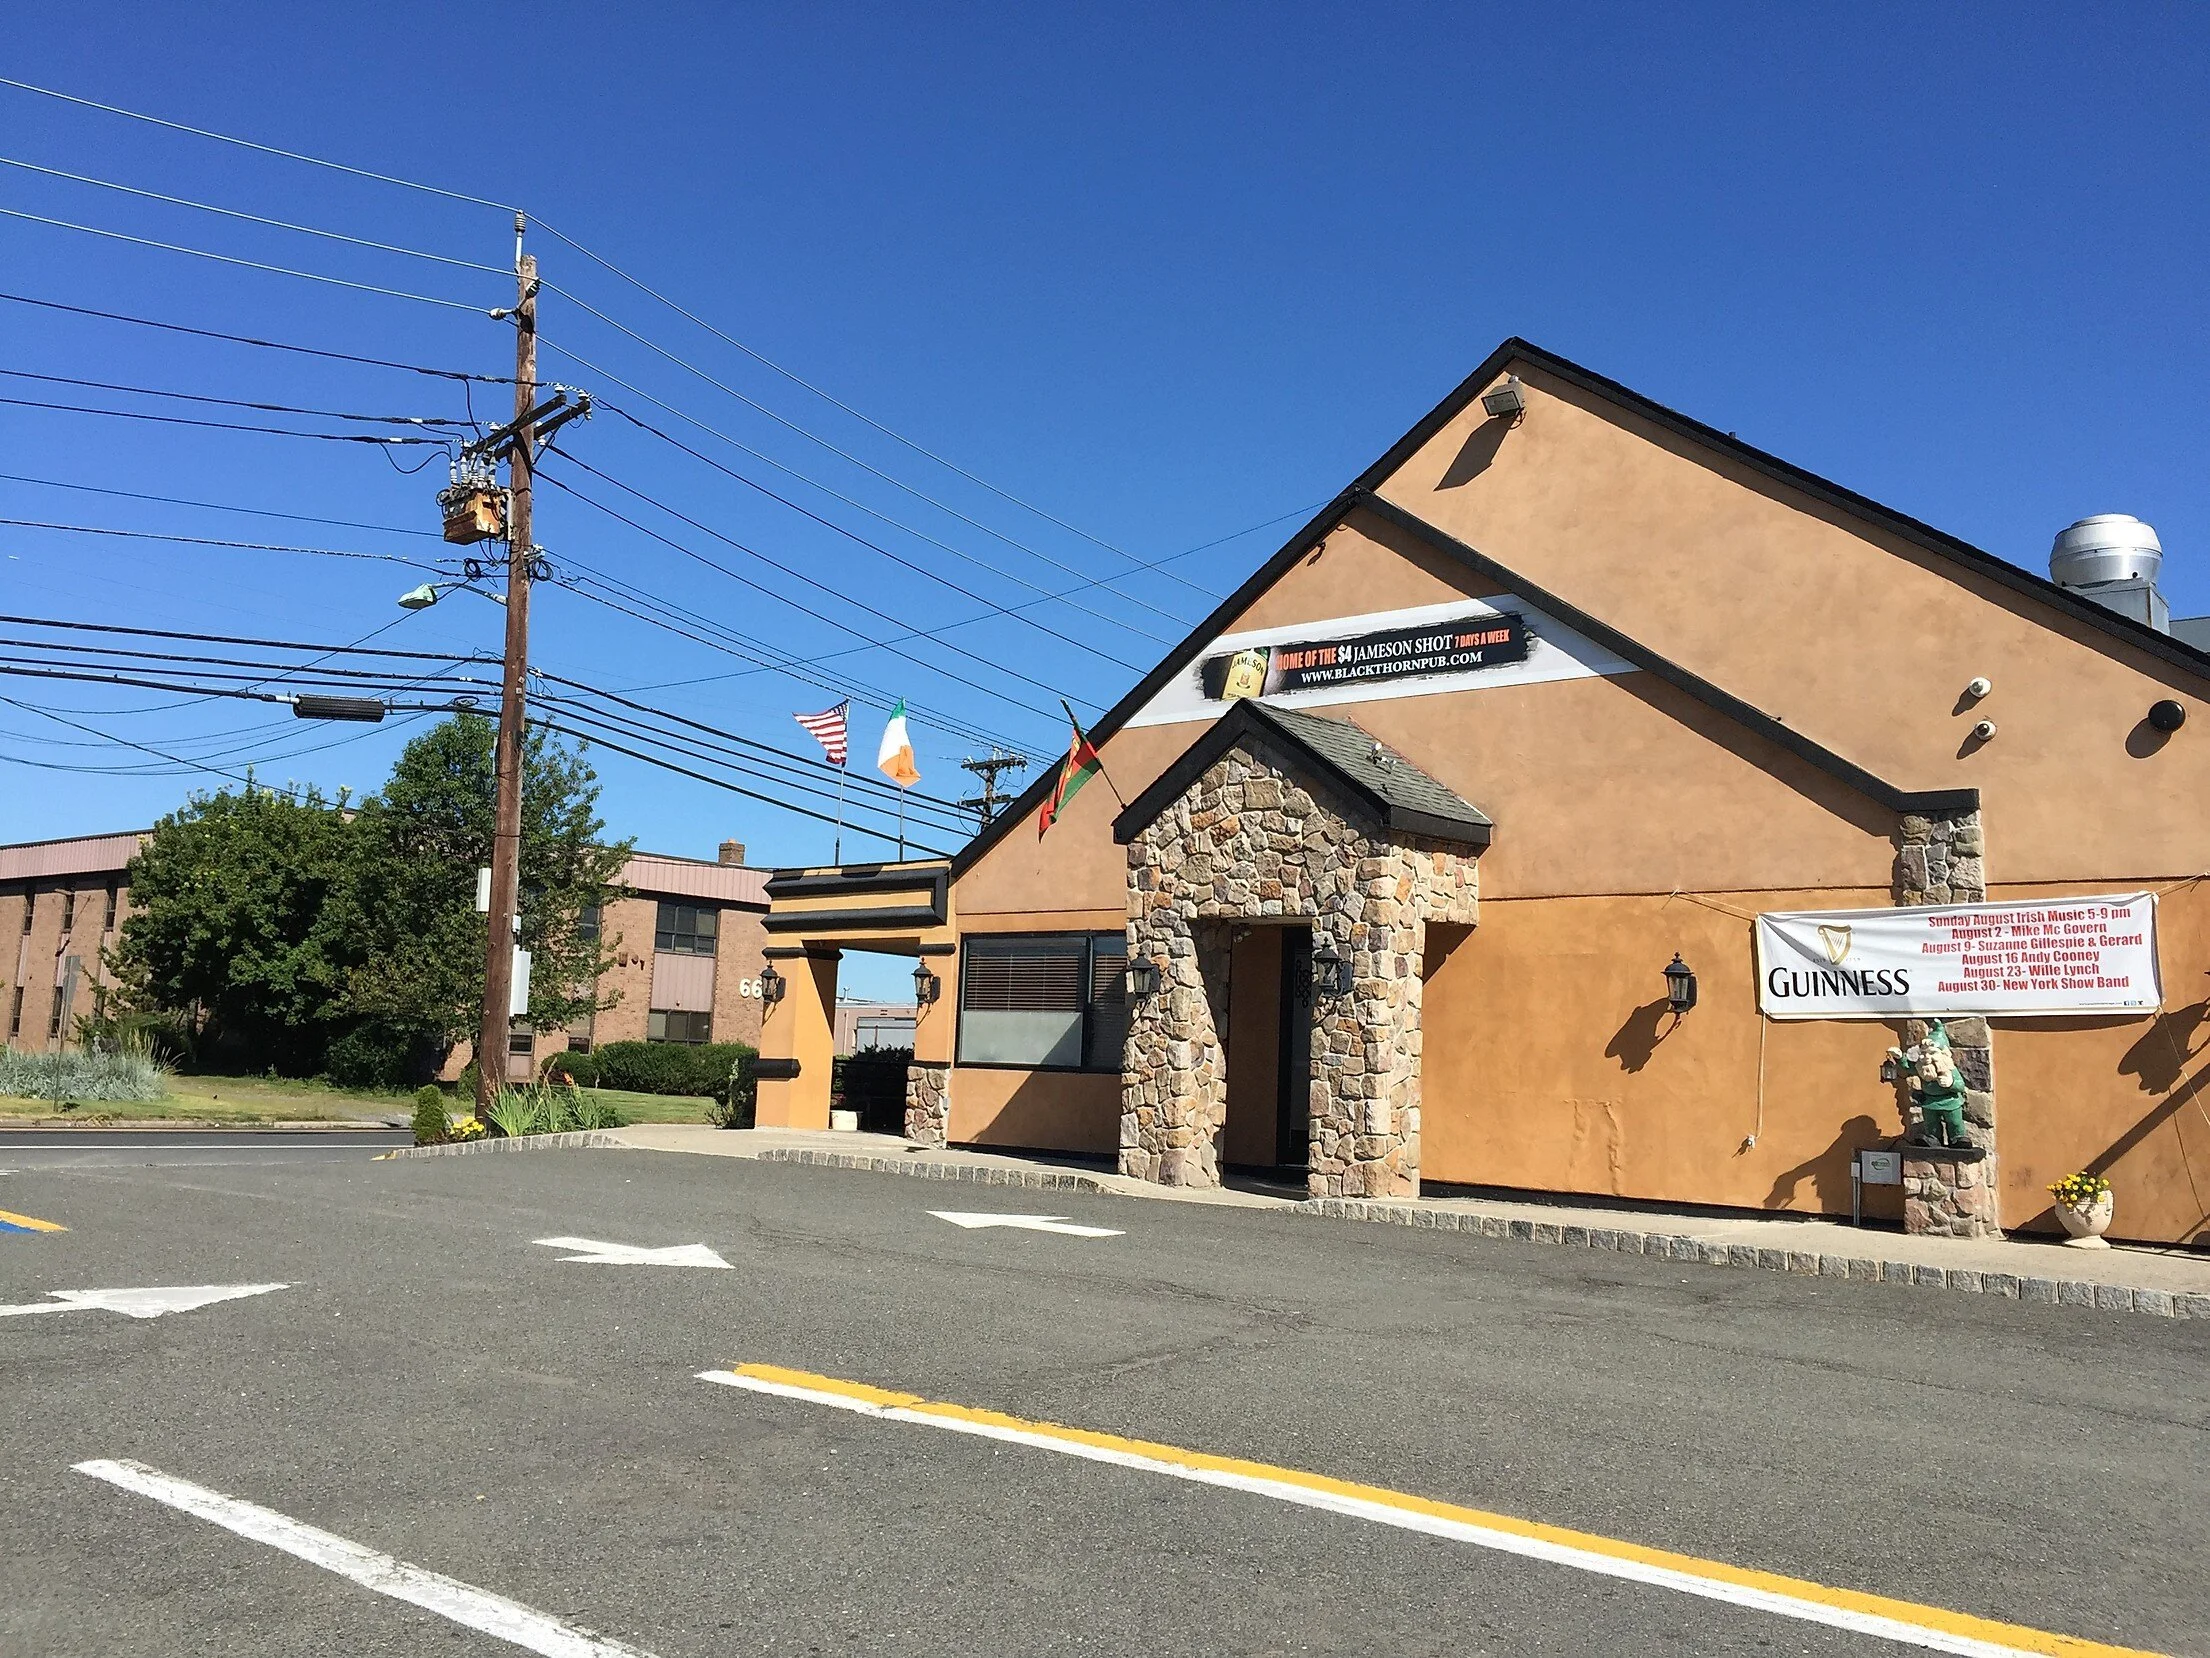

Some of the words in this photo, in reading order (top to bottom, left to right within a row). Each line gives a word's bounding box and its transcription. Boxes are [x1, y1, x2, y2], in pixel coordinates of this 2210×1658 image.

[1277, 652, 1303, 670] HOME
[1304, 649, 1318, 668] OF
[1318, 647, 1337, 666] THE
[1337, 645, 1352, 664] $4
[1352, 639, 1413, 664] JAMESON
[1414, 634, 1453, 654] SHOT
[1454, 637, 1459, 649] 7
[1459, 634, 1480, 648] DAYS
[1480, 633, 1487, 645] A
[1487, 629, 1510, 644] WEEK
[1301, 651, 1482, 683] WWW.BLACKTHORNPUB.COM
[1928, 915, 1970, 927] Sunday
[1973, 913, 2014, 926] August
[2017, 911, 2045, 923] Irish
[2047, 909, 2085, 922] Music
[2087, 907, 2108, 920] 5-9
[2111, 908, 2131, 920] pm
[1951, 927, 1992, 940] August
[1994, 926, 2002, 938] 2
[2011, 925, 2040, 936] Mike
[2043, 924, 2061, 935] Mc
[2063, 923, 2107, 934] Govern
[1921, 942, 1961, 954] August
[1978, 939, 2028, 951] Suzanne
[2030, 936, 2085, 949] Gillespie
[2088, 937, 2097, 947] &
[2099, 933, 2143, 946] Gerard
[1961, 953, 2003, 966] August
[2005, 952, 2018, 963] 16
[2021, 951, 2050, 963] Andy
[2053, 950, 2100, 962] Cooney
[1963, 966, 2004, 979] August
[2006, 965, 2026, 977] 23-
[2028, 964, 2061, 976] Wille
[2063, 963, 2100, 976] Lynch
[1768, 967, 1910, 997] GUINNESS
[1938, 980, 1978, 993] August
[1980, 979, 2000, 991] 30-
[2002, 978, 2028, 990] New
[2030, 978, 2058, 990] York
[2061, 977, 2094, 989] Show
[2097, 976, 2129, 988] Band
